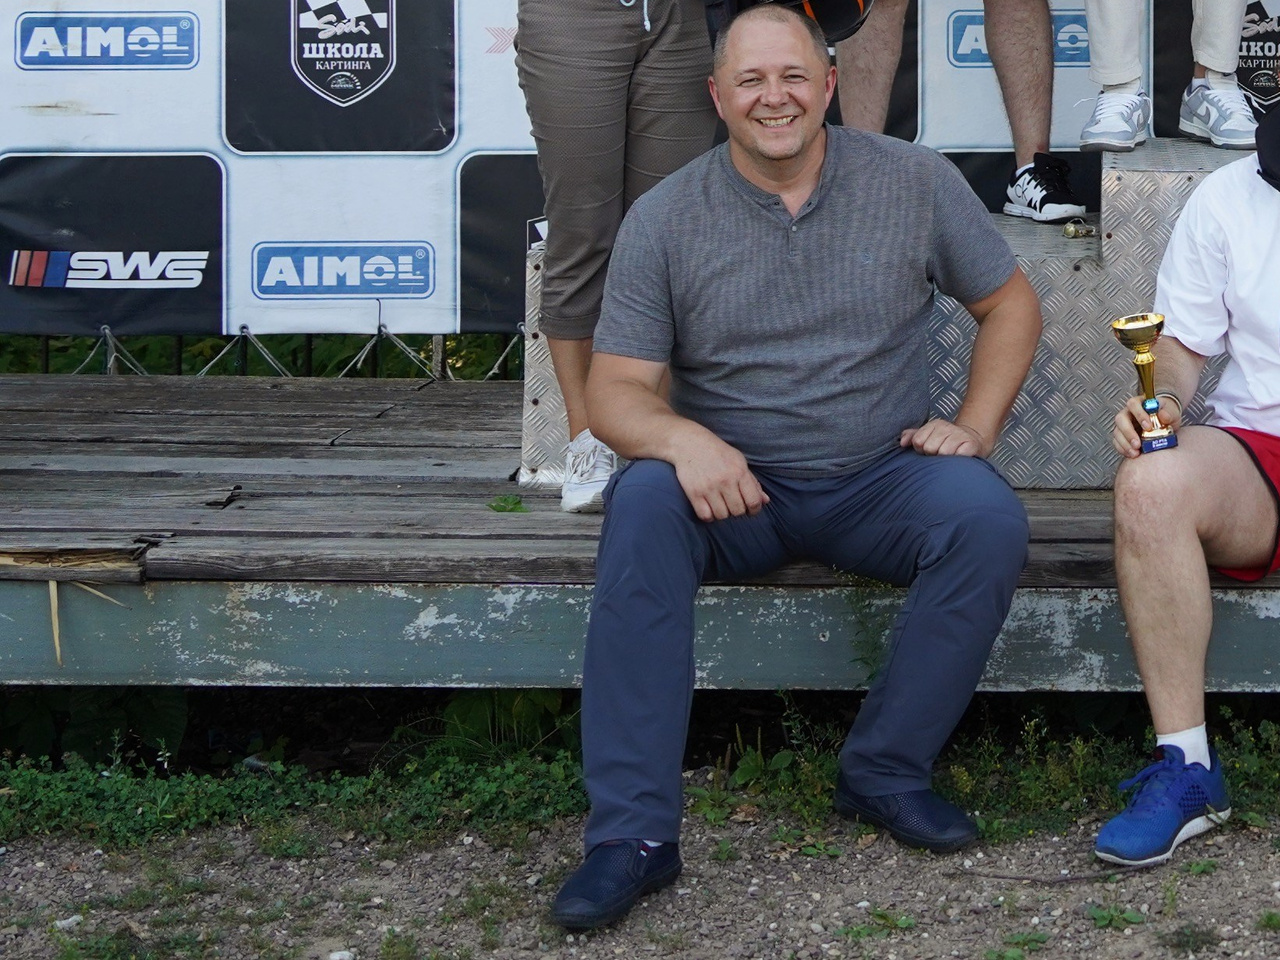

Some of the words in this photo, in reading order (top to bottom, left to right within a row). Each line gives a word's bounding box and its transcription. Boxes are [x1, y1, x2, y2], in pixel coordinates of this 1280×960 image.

[24, 26, 189, 57] AIMOL
[303, 43, 383, 58] ШКОЛА
[316, 60, 370, 69] КАРТИНГА
[1239, 60, 1280, 68] КАРТИН
[66, 251, 209, 287] SWS
[261, 255, 424, 287] AIMOL
